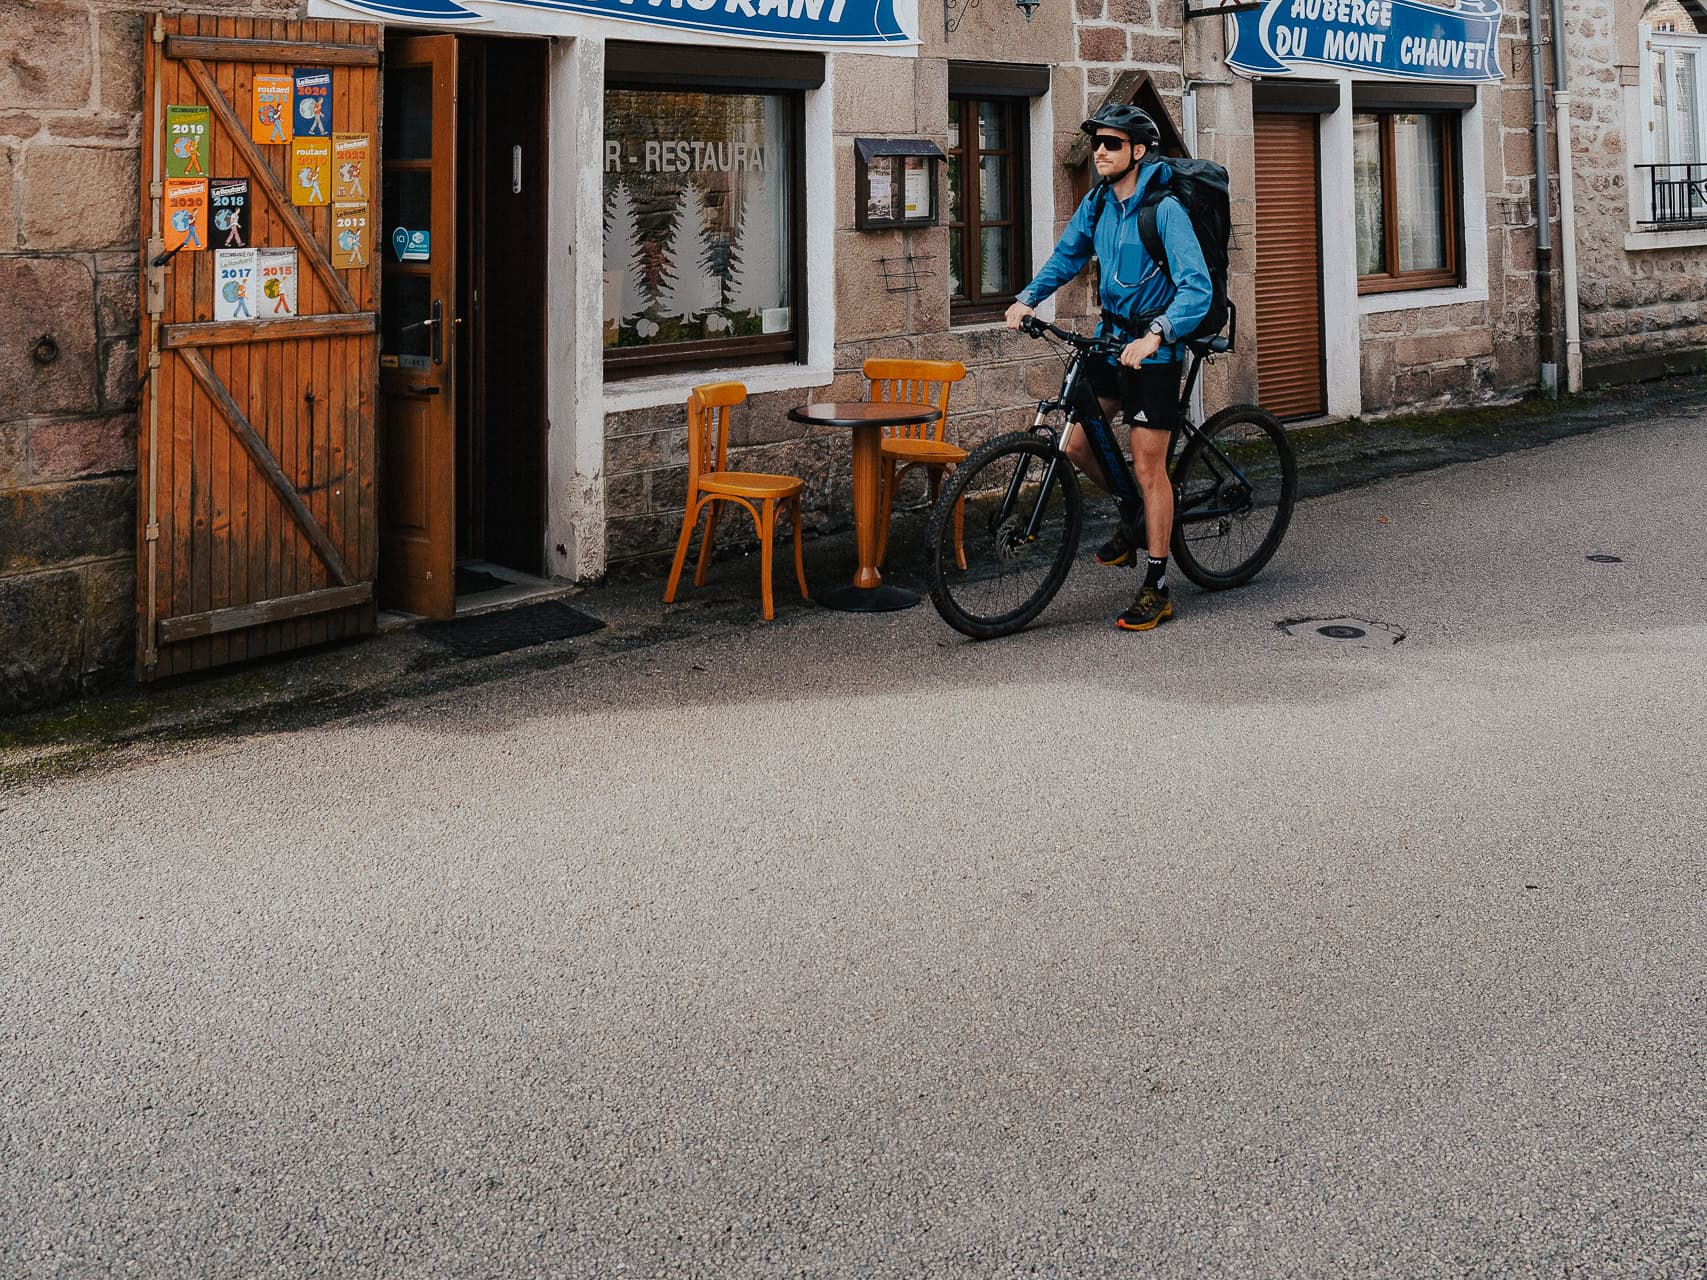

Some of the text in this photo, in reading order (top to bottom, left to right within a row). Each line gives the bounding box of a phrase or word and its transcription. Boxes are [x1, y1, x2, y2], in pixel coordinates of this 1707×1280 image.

[1275, 25, 1486, 70] DU MONT CHAUVET
[297, 86, 327, 96] 2024
[259, 94, 288, 102] 2011
[172, 124, 204, 135] 2019
[336, 151, 366, 160] 2023
[169, 197, 204, 208] 2020
[213, 196, 244, 207] 2018
[336, 218, 366, 228] 2013
[221, 268, 252, 279] 2017
[263, 266, 293, 276] 2015
